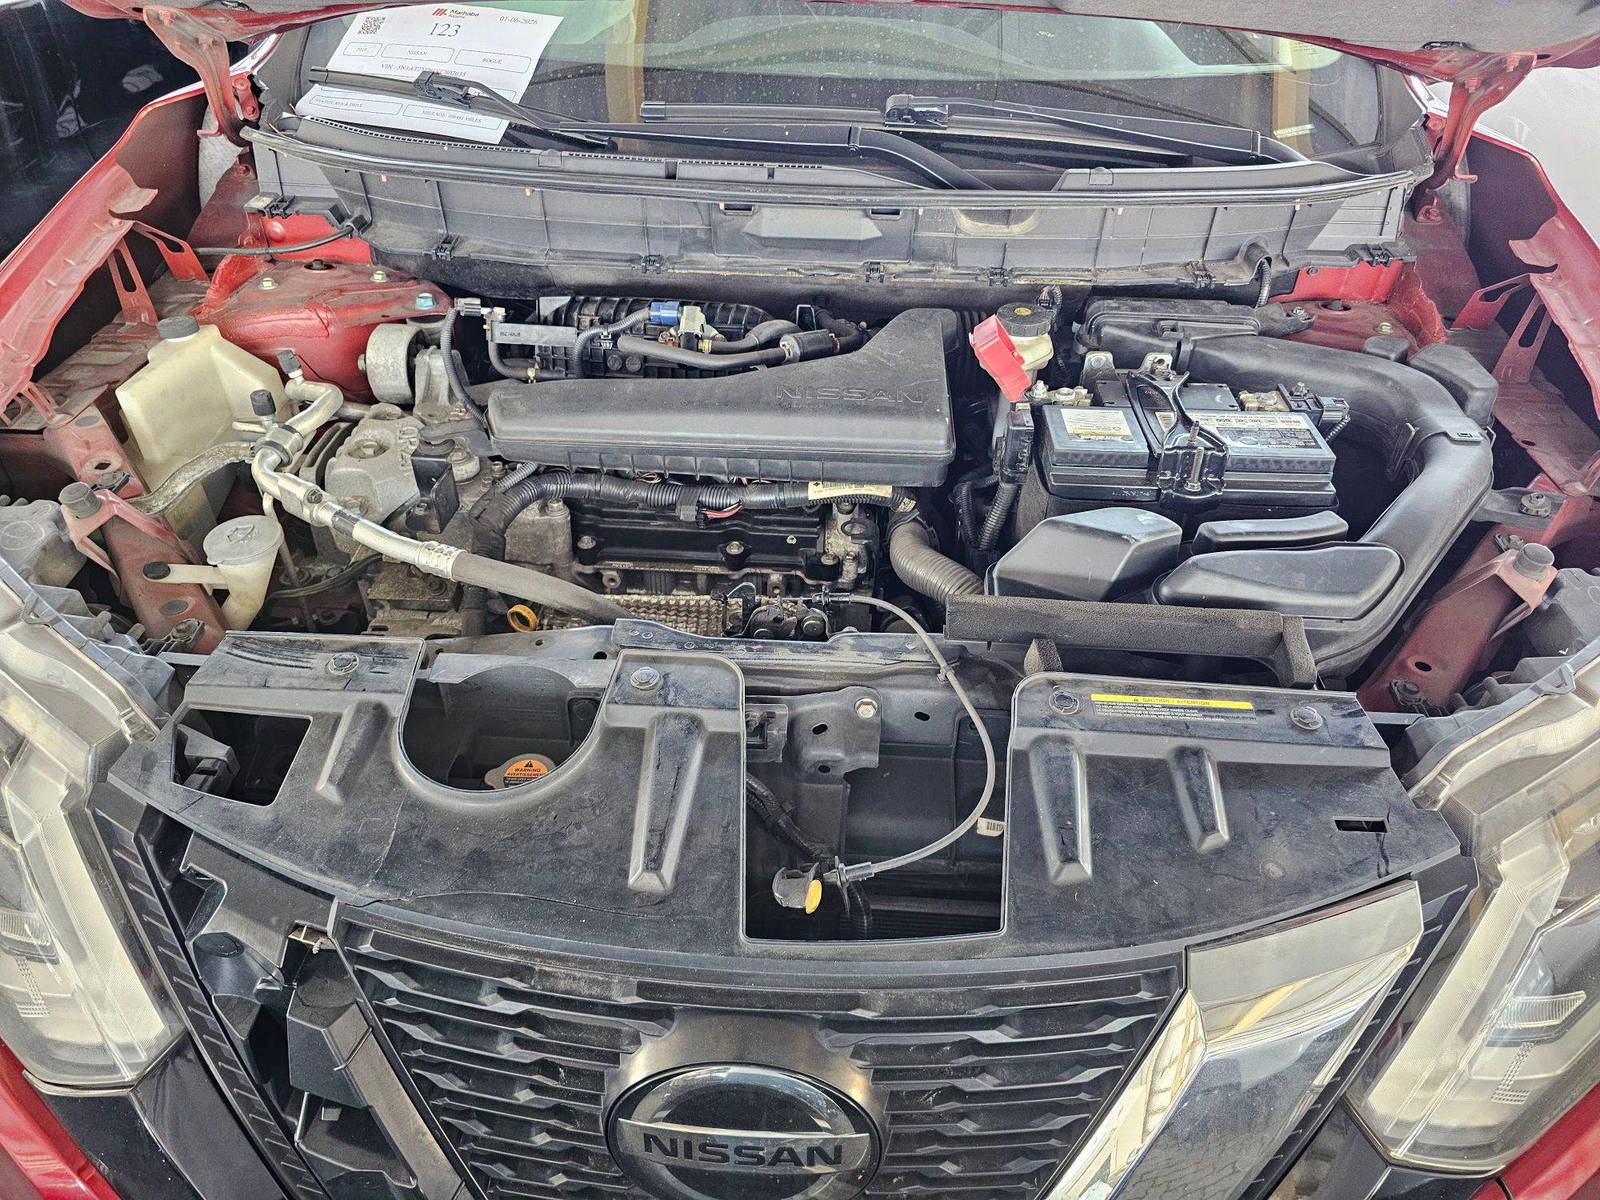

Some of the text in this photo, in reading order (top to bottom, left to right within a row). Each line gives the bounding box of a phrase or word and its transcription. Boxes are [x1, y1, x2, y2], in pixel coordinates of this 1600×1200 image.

[449, 9, 480, 17] Marhaba
[429, 22, 461, 37] 123
[482, 57, 503, 65] ROGUE
[776, 384, 923, 404] NISSAN
[643, 1132, 843, 1167] NISSAN
